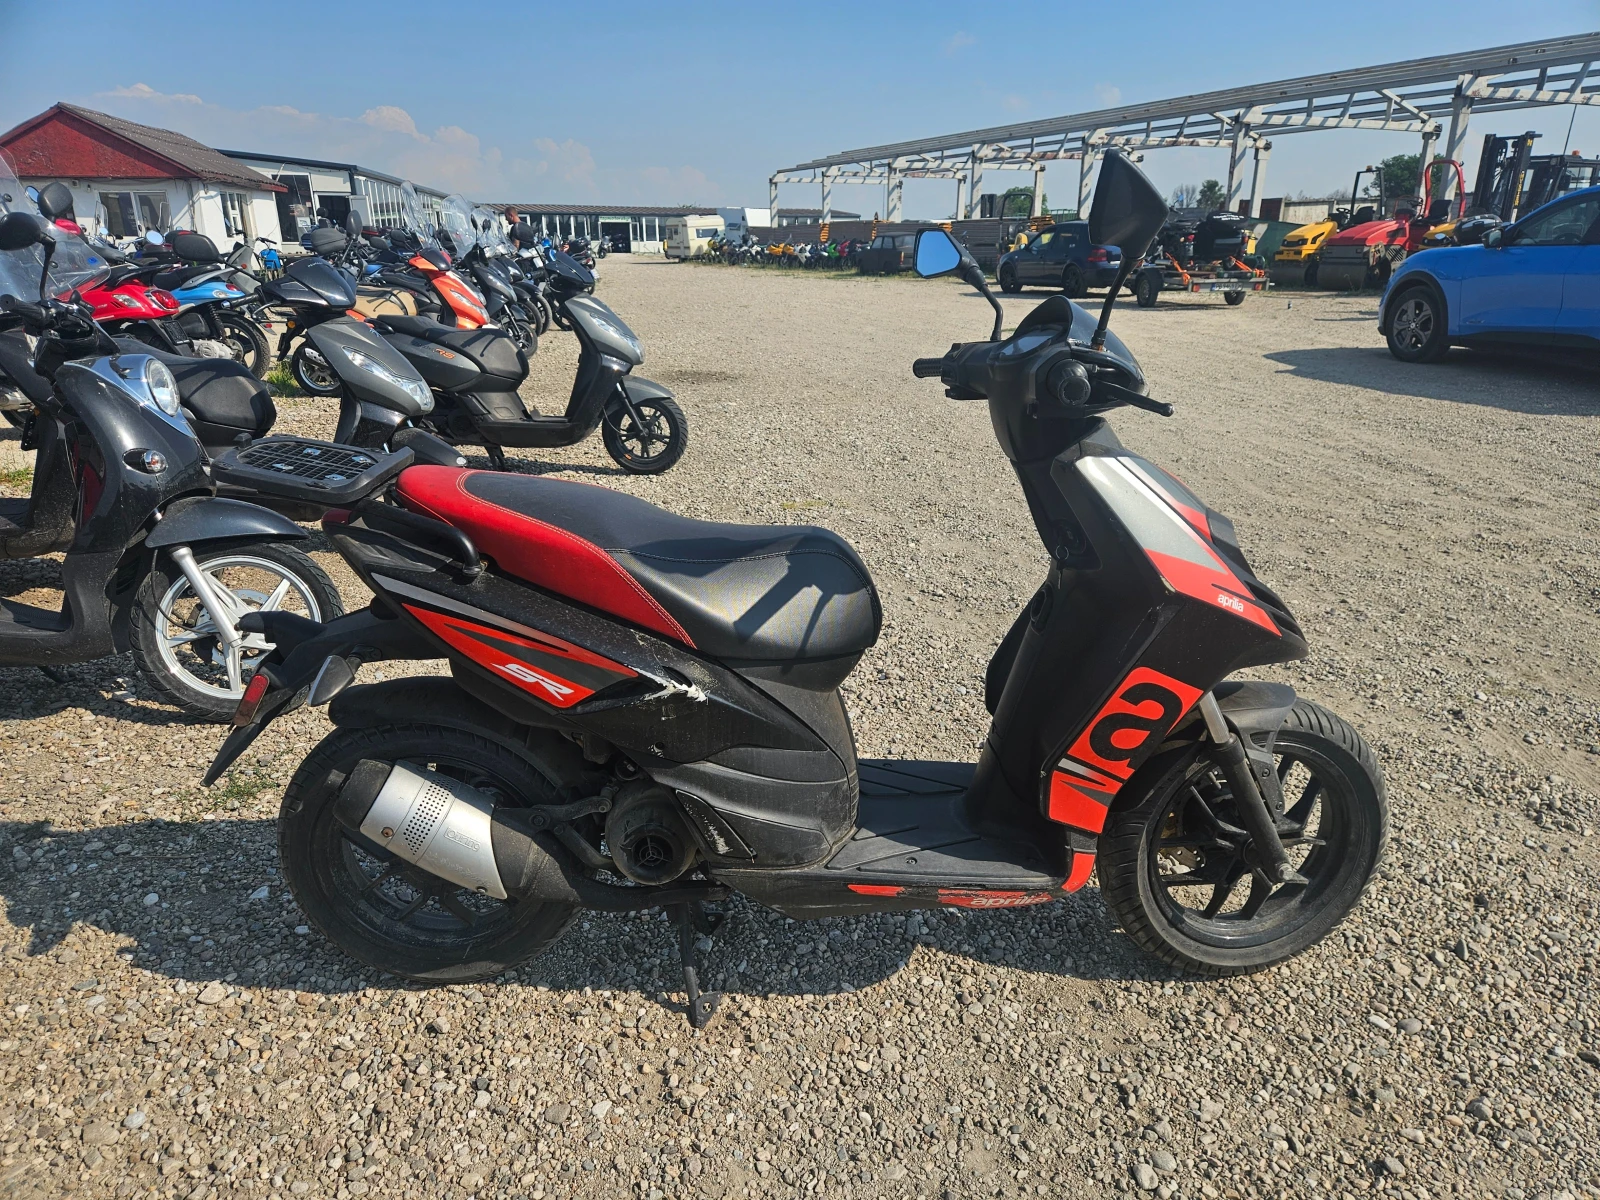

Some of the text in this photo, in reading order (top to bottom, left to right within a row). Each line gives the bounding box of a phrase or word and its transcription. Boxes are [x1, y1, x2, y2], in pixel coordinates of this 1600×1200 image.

[1217, 594, 1244, 613] aprilia
[490, 663, 575, 702] SR
[970, 895, 1049, 907] aprilia
